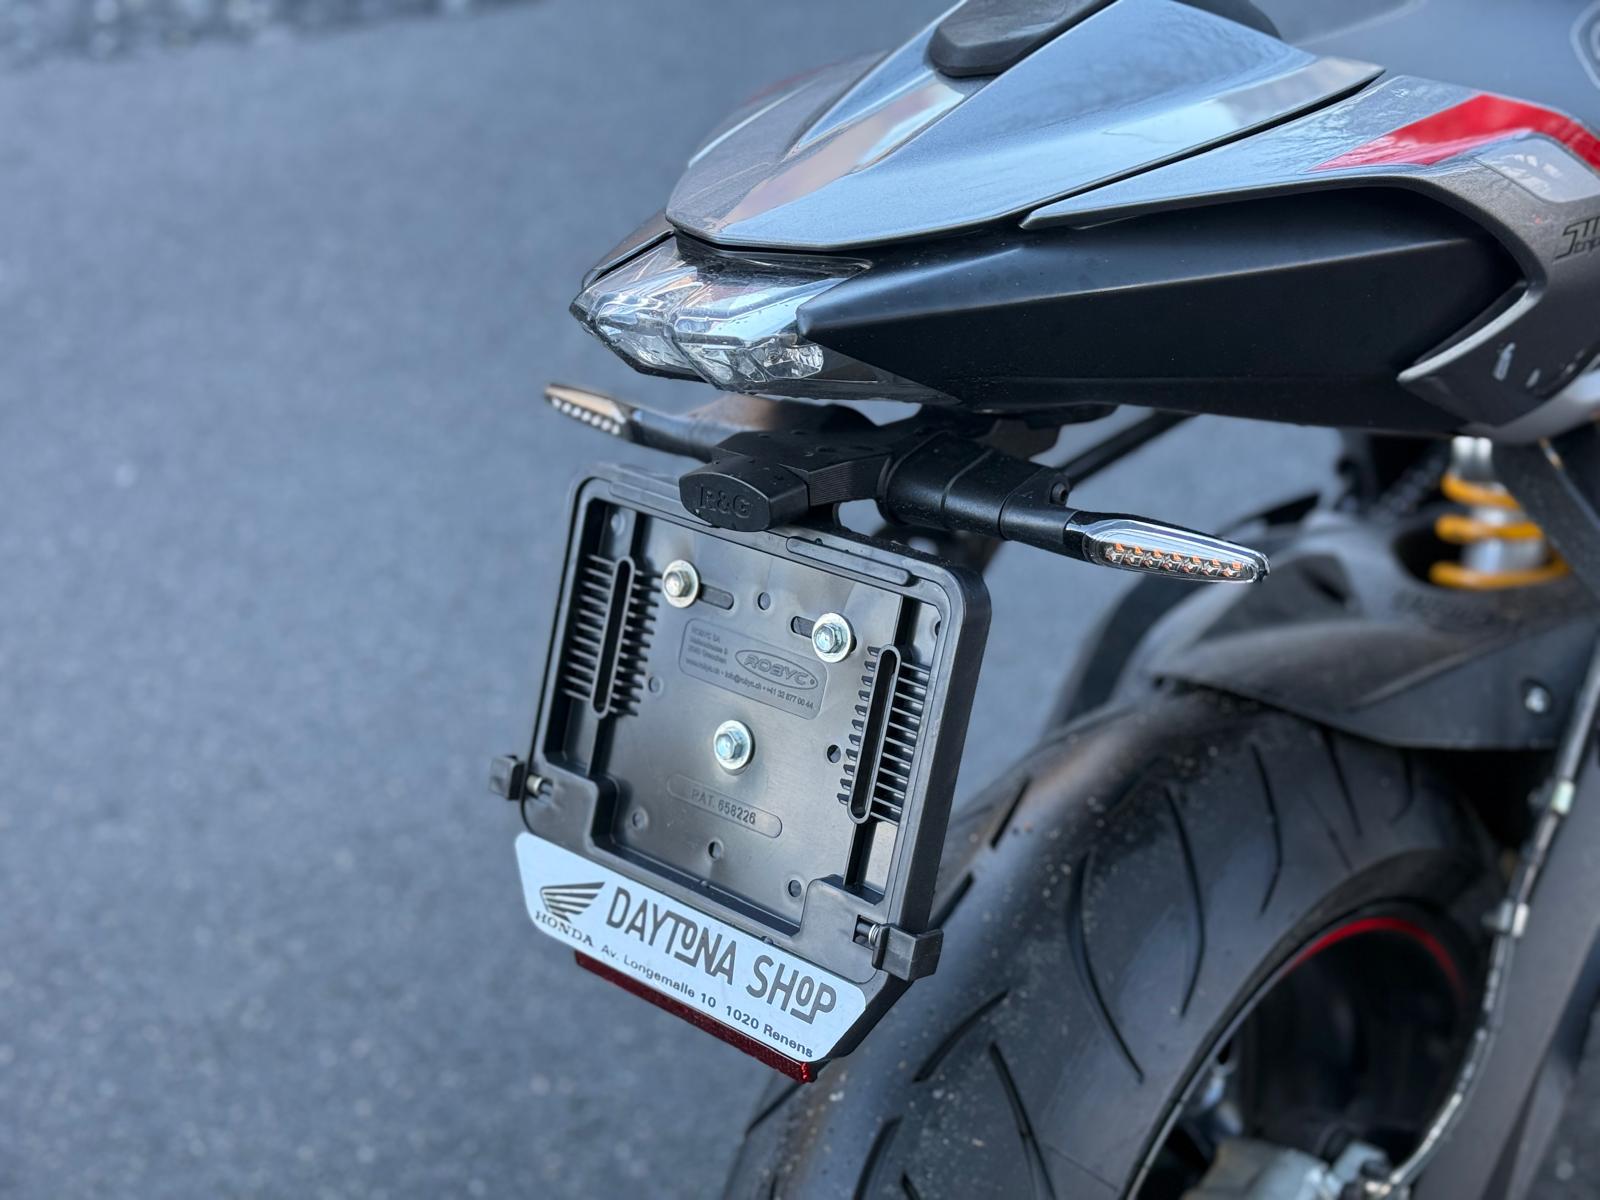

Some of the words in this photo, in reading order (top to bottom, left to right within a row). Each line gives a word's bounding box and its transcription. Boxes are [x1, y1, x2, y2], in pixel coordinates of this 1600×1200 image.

[700, 486, 752, 518] R&G
[744, 654, 809, 686] ROBYC
[691, 788, 715, 808] PAT.
[718, 799, 756, 825] 658226
[535, 910, 594, 947] HONDA
[606, 886, 737, 985] DAYTONA
[745, 954, 837, 1025] SHOP
[601, 944, 620, 961] Av.
[623, 954, 695, 998] Longemalle
[701, 992, 717, 1009] 10
[726, 1005, 760, 1030] 1020
[763, 1023, 814, 1058] Renens
